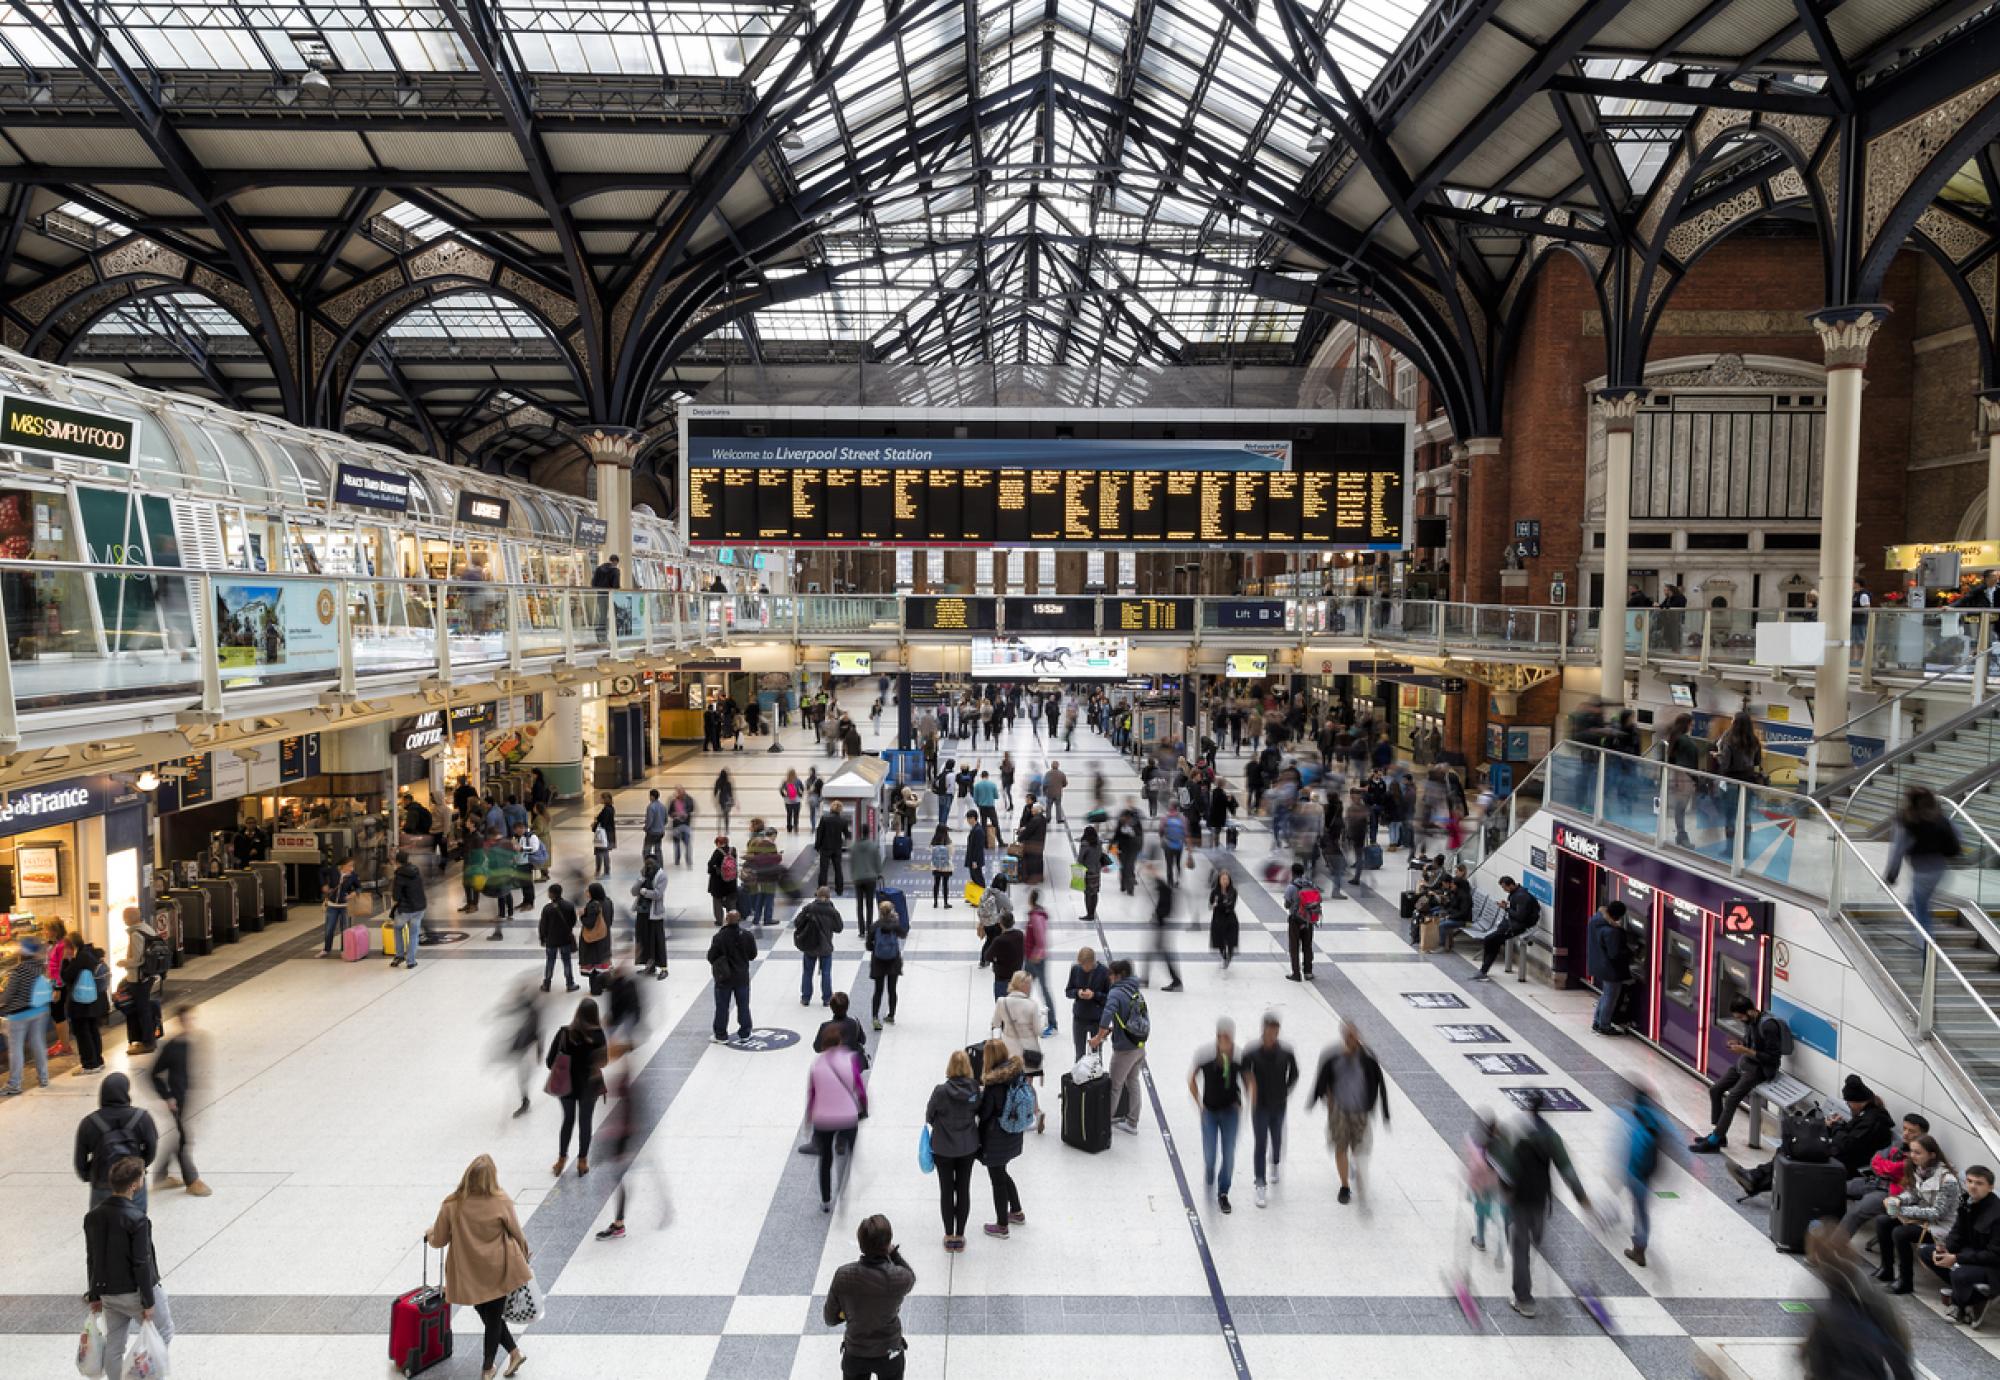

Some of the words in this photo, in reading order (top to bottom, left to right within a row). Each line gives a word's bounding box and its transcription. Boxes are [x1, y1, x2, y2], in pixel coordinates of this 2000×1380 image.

[692, 407, 731, 416] Departures
[10, 412, 44, 436] M&S
[44, 419, 88, 443] SIMPLY
[88, 427, 125, 450] FOOD
[712, 448, 760, 460] Welcome
[762, 449, 774, 460] to
[776, 446, 837, 463] Liverpool
[839, 447, 880, 461] Street
[883, 447, 933, 461] Station
[1235, 609, 1251, 619] Lift
[416, 711, 439, 728] AMT
[309, 733, 318, 756] 5
[406, 728, 443, 750] COFFEE
[16, 795, 30, 815] de
[30, 788, 89, 815] France
[1564, 830, 1600, 861] NatWest
